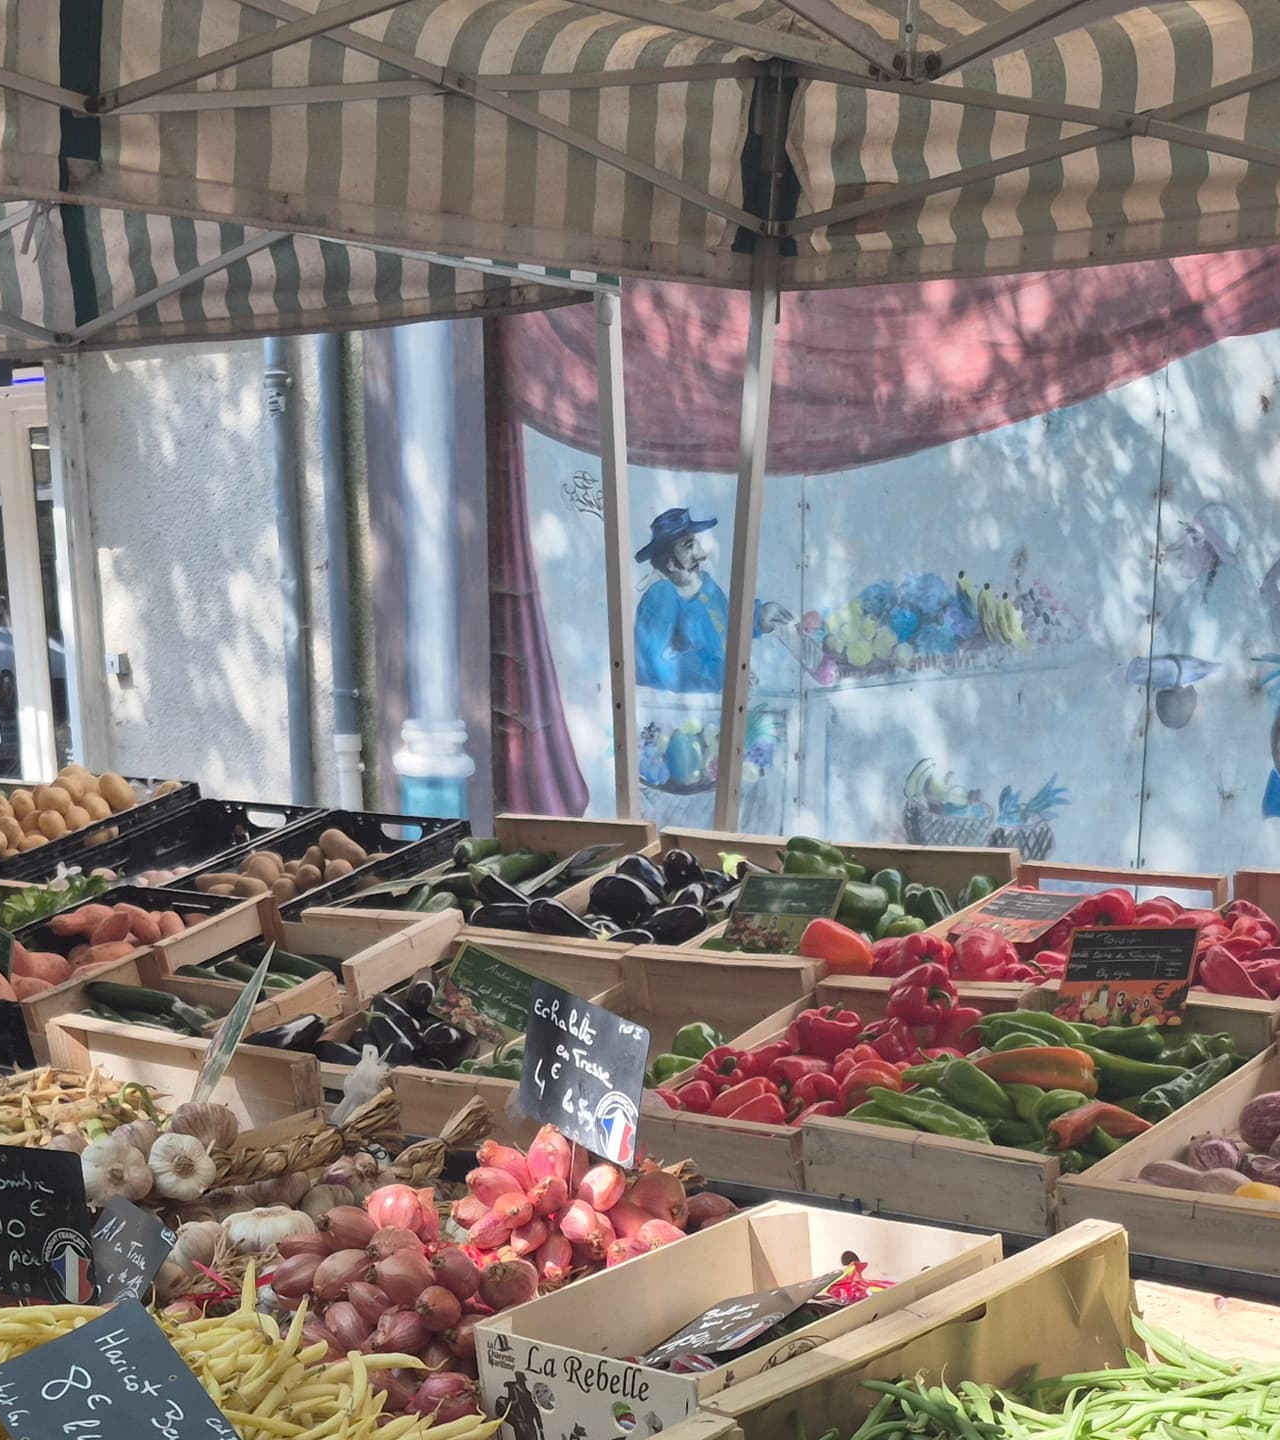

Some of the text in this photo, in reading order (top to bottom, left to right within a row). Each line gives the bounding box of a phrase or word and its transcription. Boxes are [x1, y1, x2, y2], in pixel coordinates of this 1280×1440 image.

[550, 1062, 562, 1080] €
[29, 1199, 47, 1217] €
[93, 1328, 164, 1398] Haricot
[524, 1345, 650, 1402] La Rebelle
[40, 1364, 93, 1401] 8
